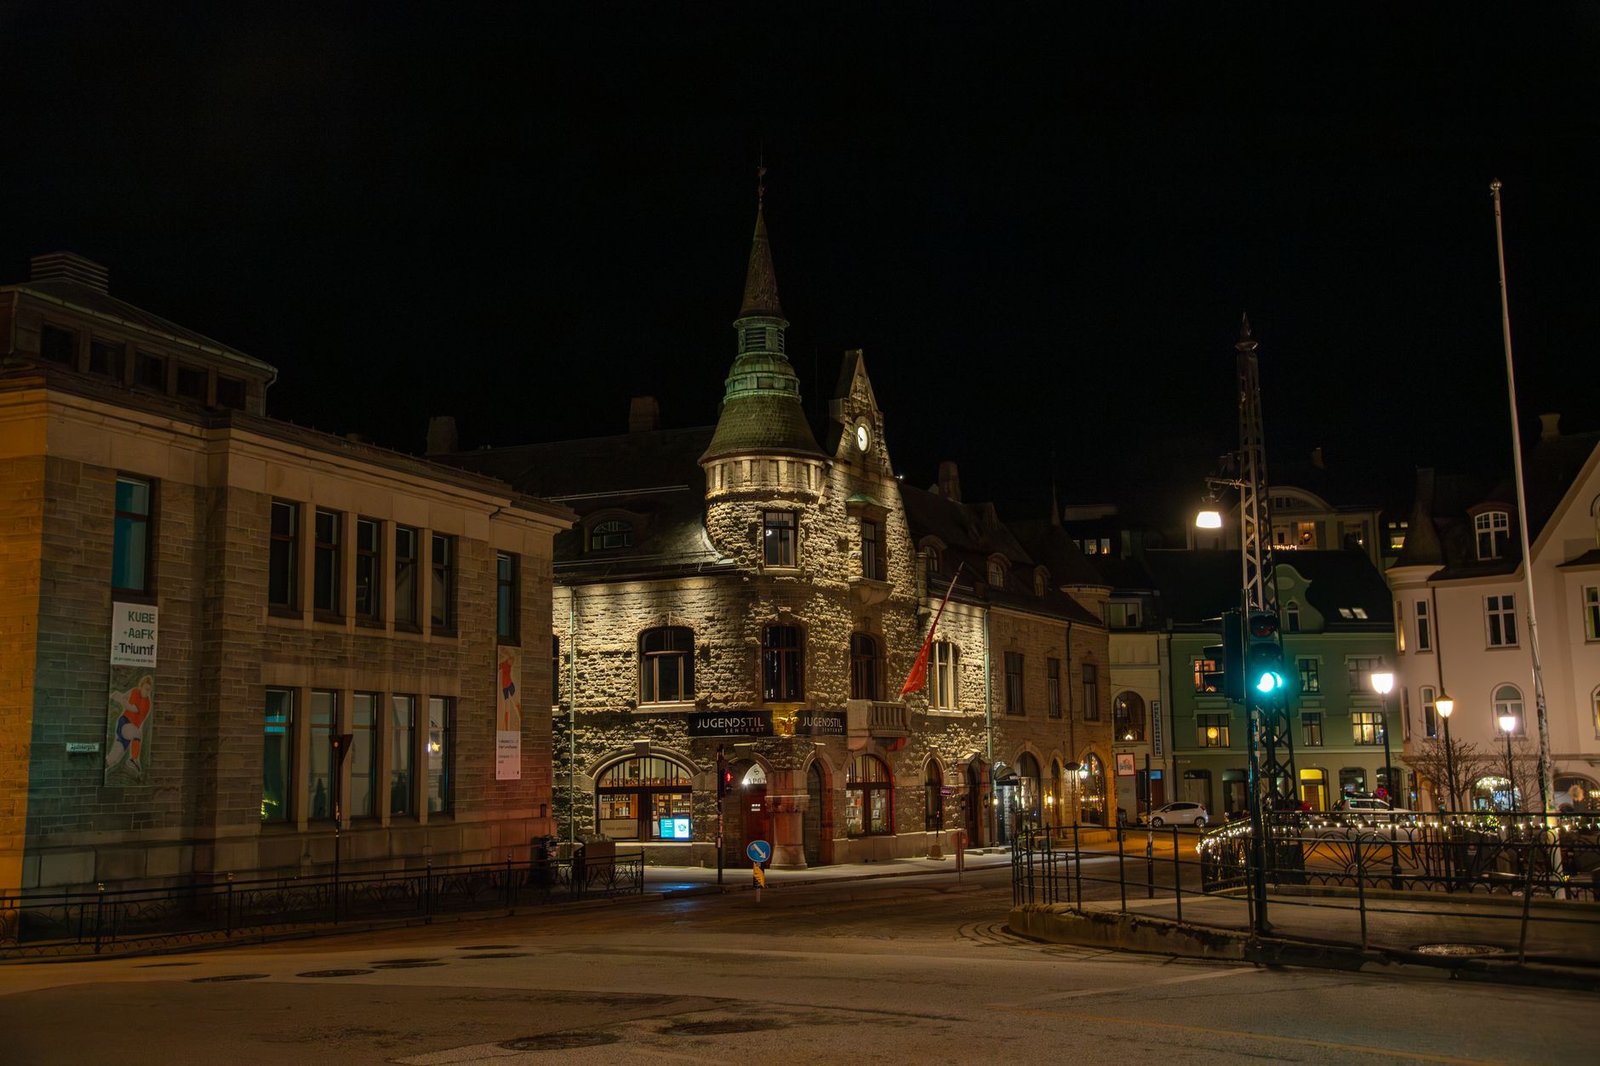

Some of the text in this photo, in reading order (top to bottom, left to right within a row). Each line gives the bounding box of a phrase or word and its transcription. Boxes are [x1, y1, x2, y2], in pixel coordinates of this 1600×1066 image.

[128, 611, 156, 624] KUBE
[128, 627, 154, 641] AaFK
[119, 642, 154, 656] Triumf
[697, 716, 765, 729] JUGENDSTIL
[802, 716, 843, 728] JUGENDSTIL
